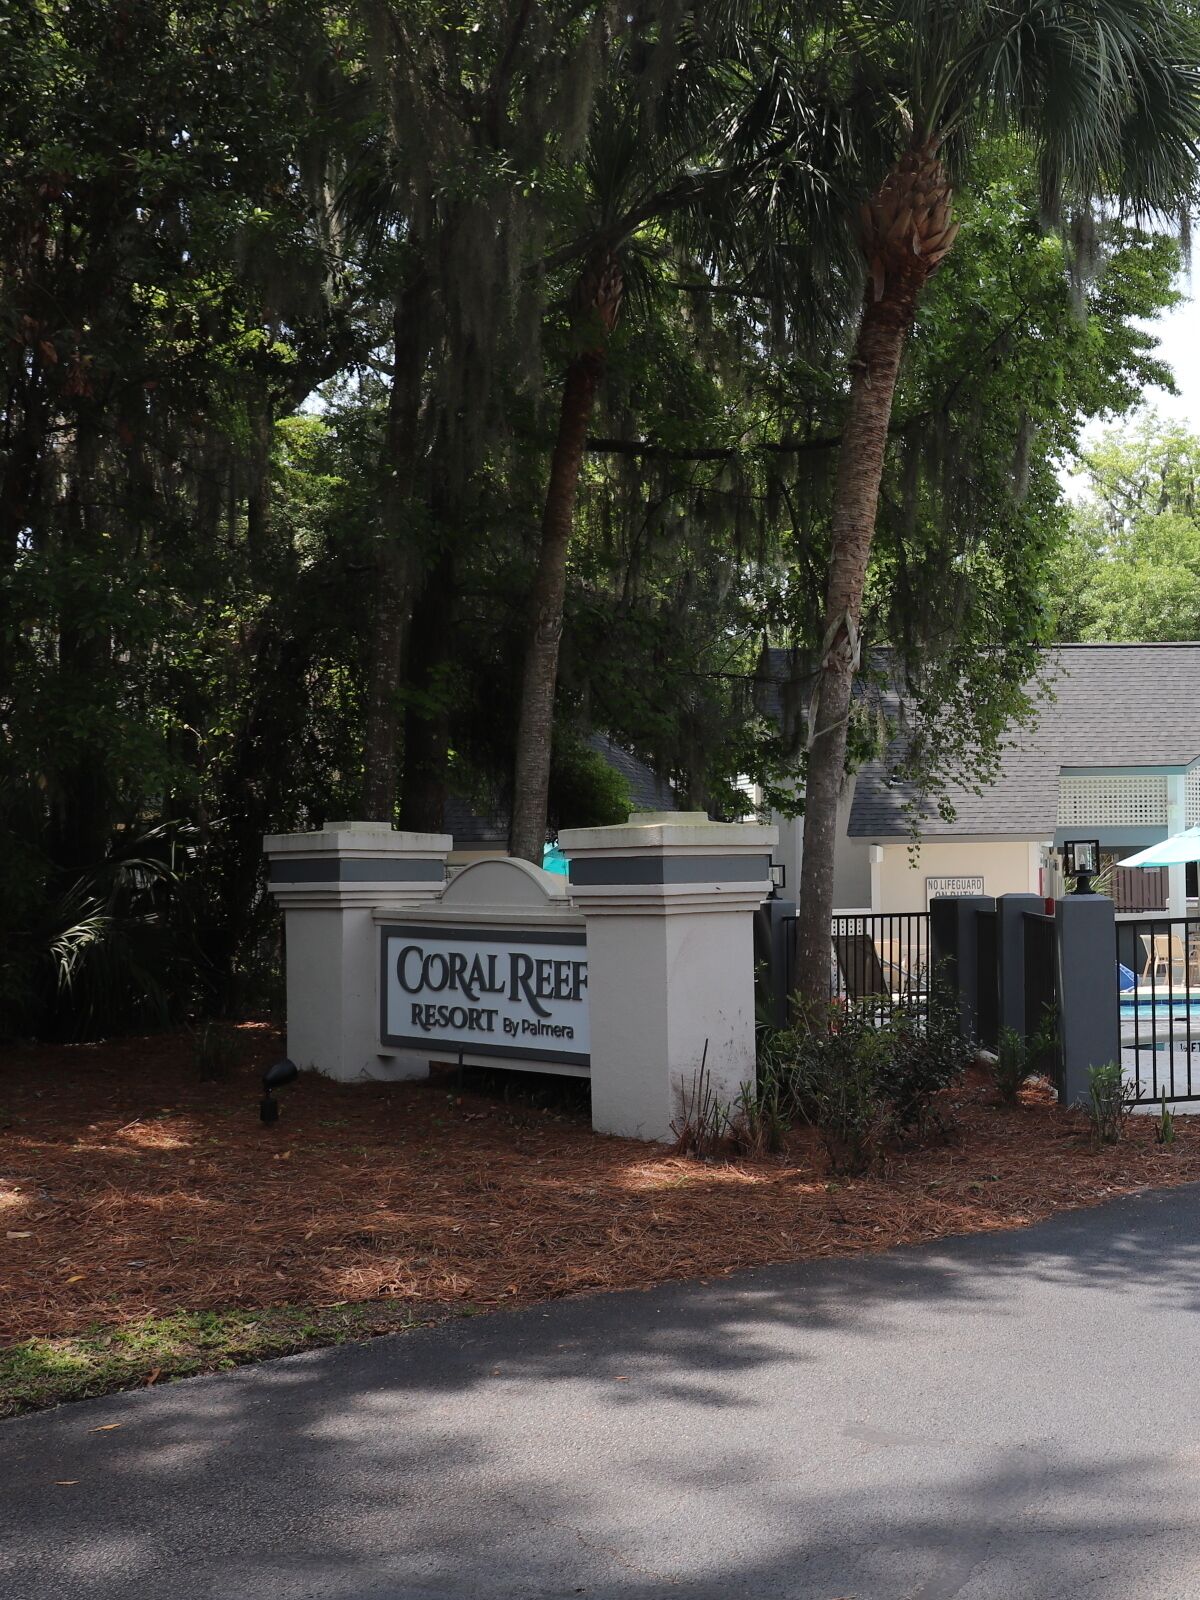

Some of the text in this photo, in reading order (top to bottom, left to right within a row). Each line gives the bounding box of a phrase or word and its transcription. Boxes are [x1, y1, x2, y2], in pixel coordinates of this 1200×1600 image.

[928, 879, 981, 890] NO LIFEGUARD
[397, 945, 588, 1017] CORAL REEF
[411, 1003, 574, 1040] RESORT By Palmera
